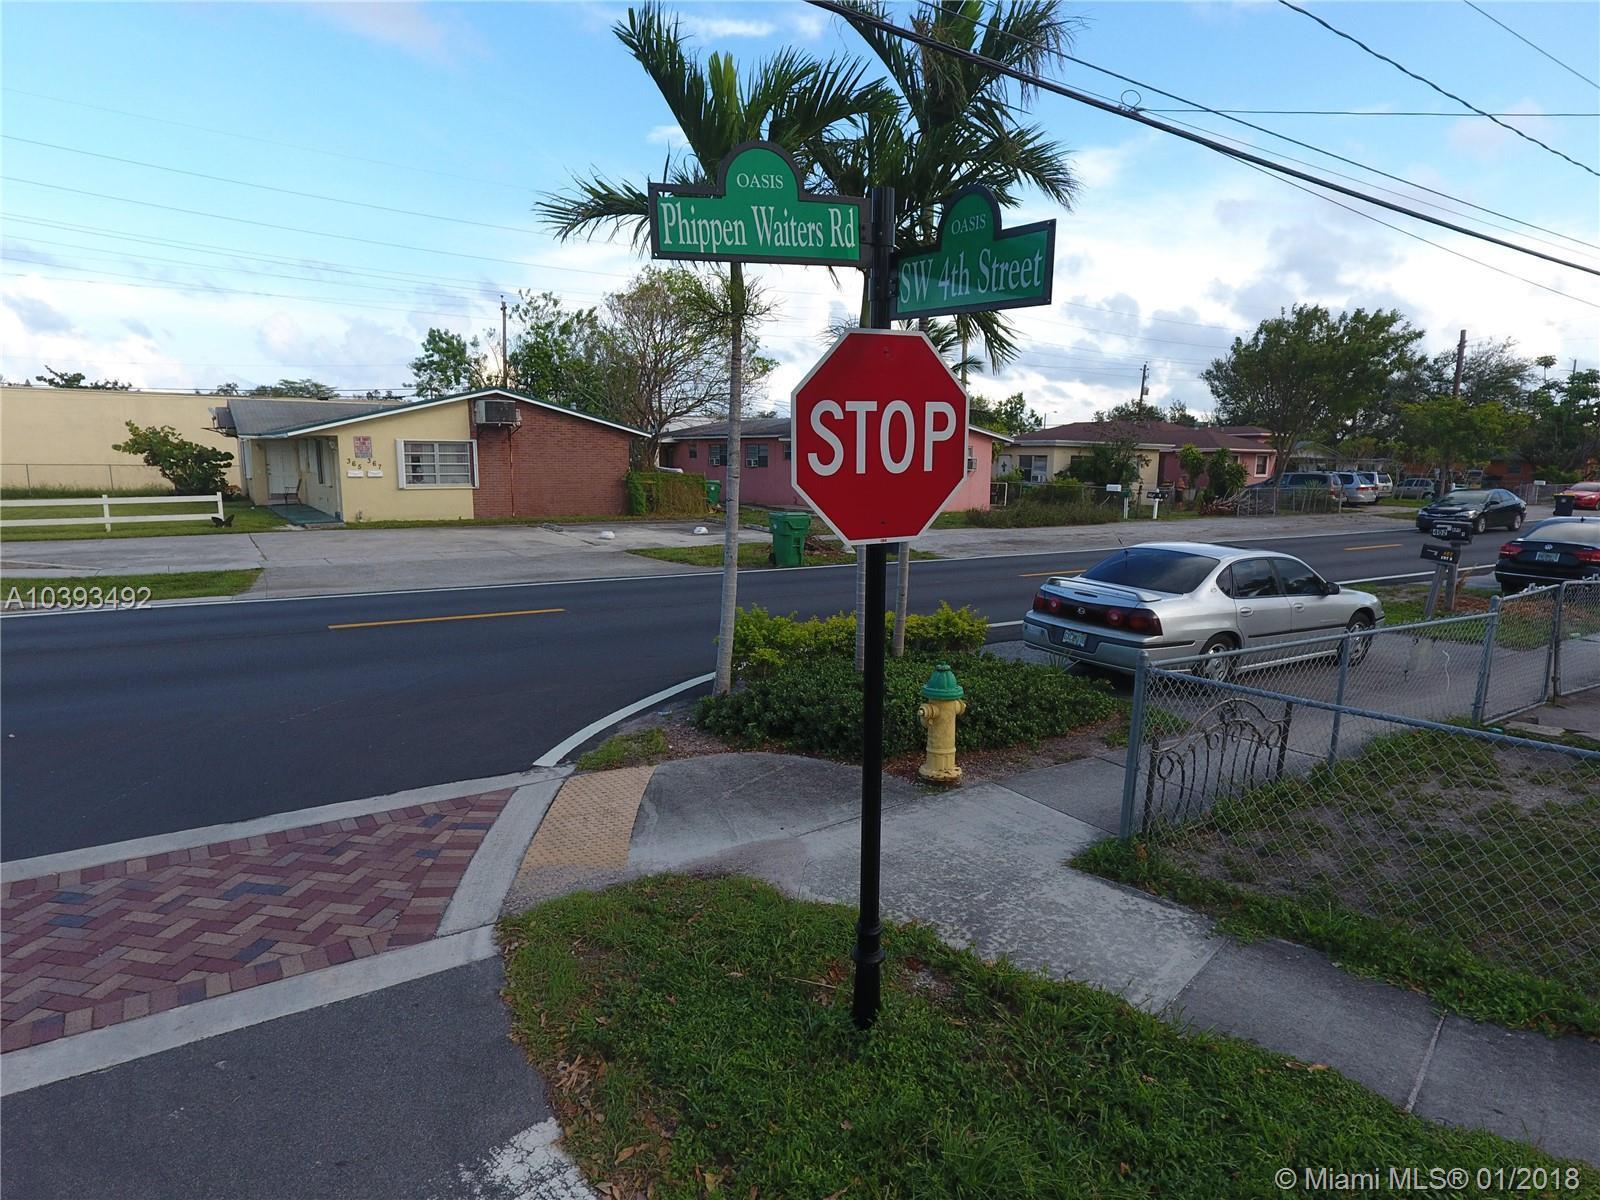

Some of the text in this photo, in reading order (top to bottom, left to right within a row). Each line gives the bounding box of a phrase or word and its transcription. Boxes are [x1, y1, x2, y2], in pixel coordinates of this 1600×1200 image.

[736, 173, 784, 189] OASIS
[660, 202, 856, 253] Phippen Waiters Rd
[951, 213, 986, 235] OASIS
[900, 248, 1042, 304] SW 4th Street
[808, 400, 957, 476] STOP
